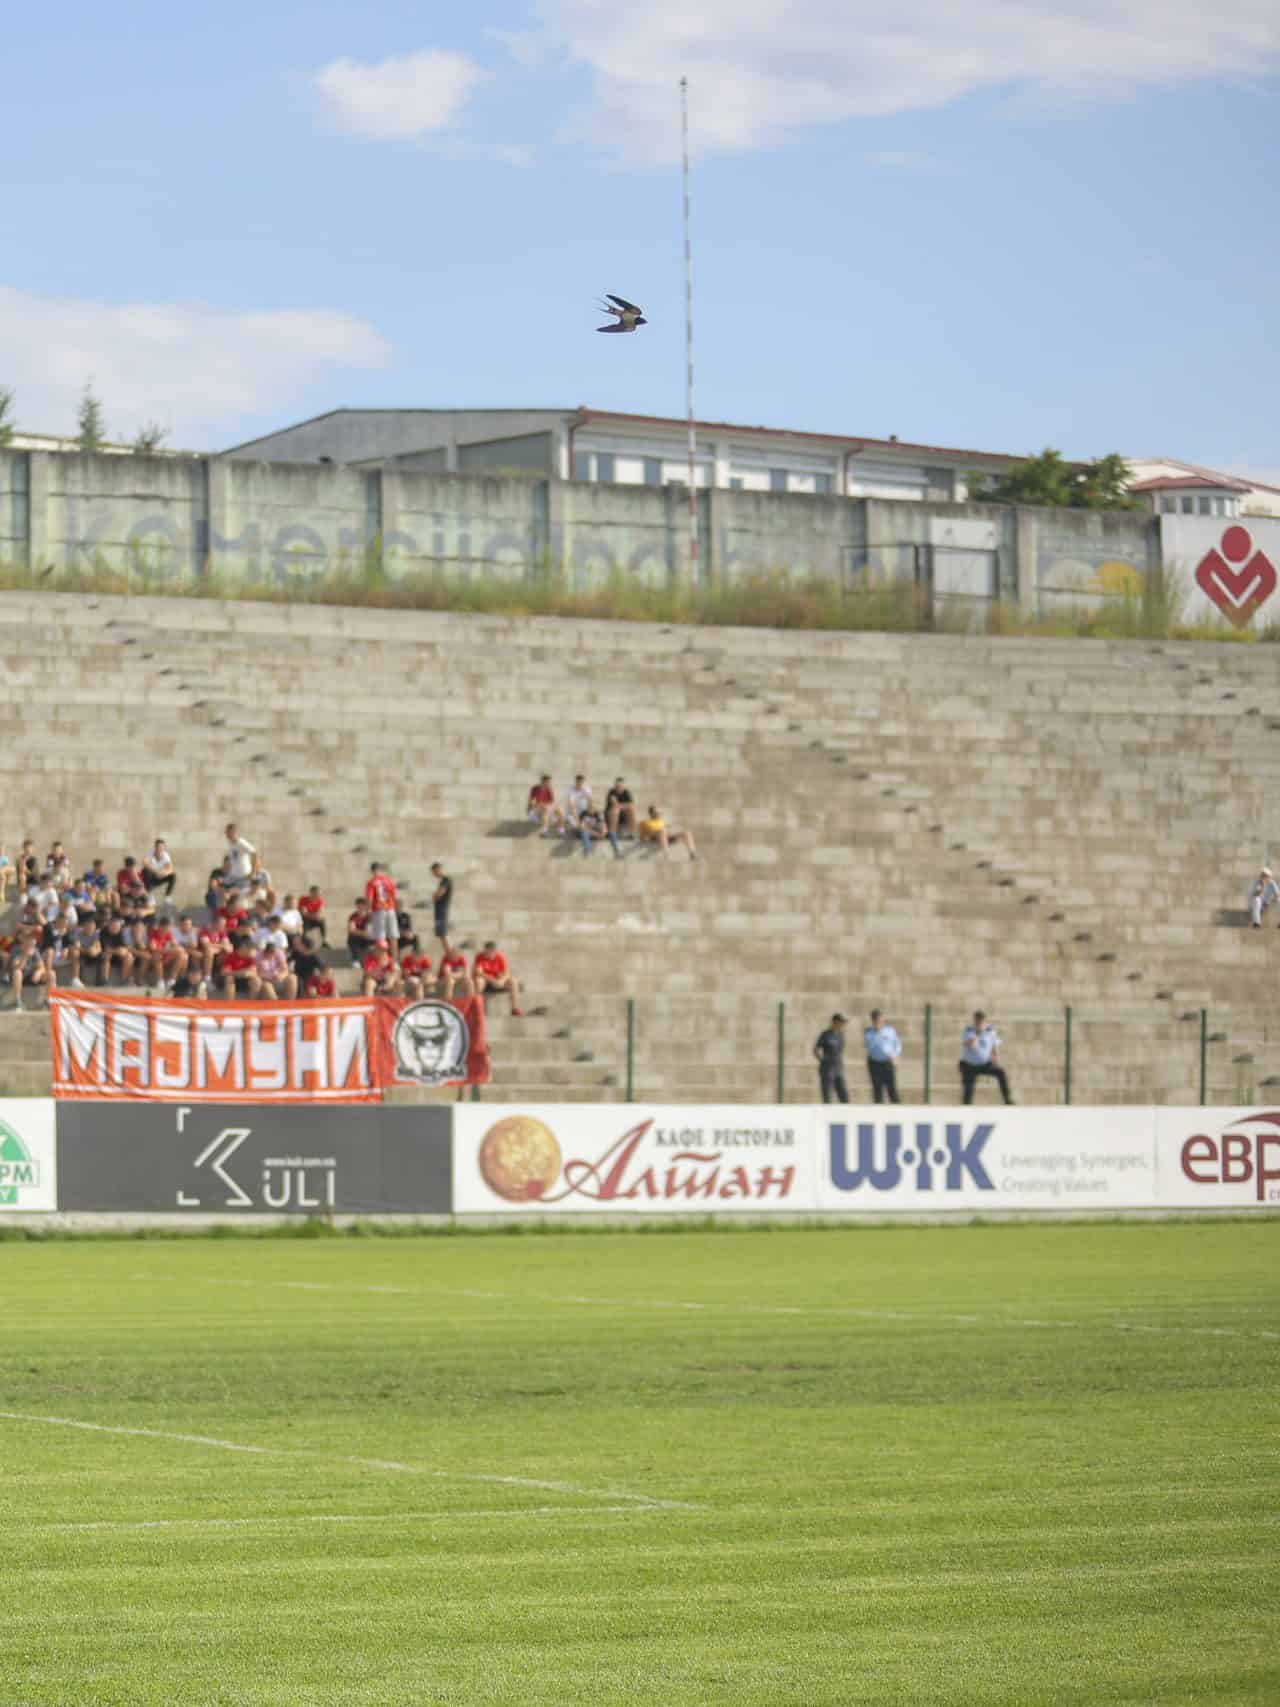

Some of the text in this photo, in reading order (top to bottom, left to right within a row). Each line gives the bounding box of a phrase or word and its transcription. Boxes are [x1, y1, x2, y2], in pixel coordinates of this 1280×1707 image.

[57, 1004, 370, 1089] МАЈМУНИ
[656, 1127, 795, 1148] КАФЕ РЕСТОРАН
